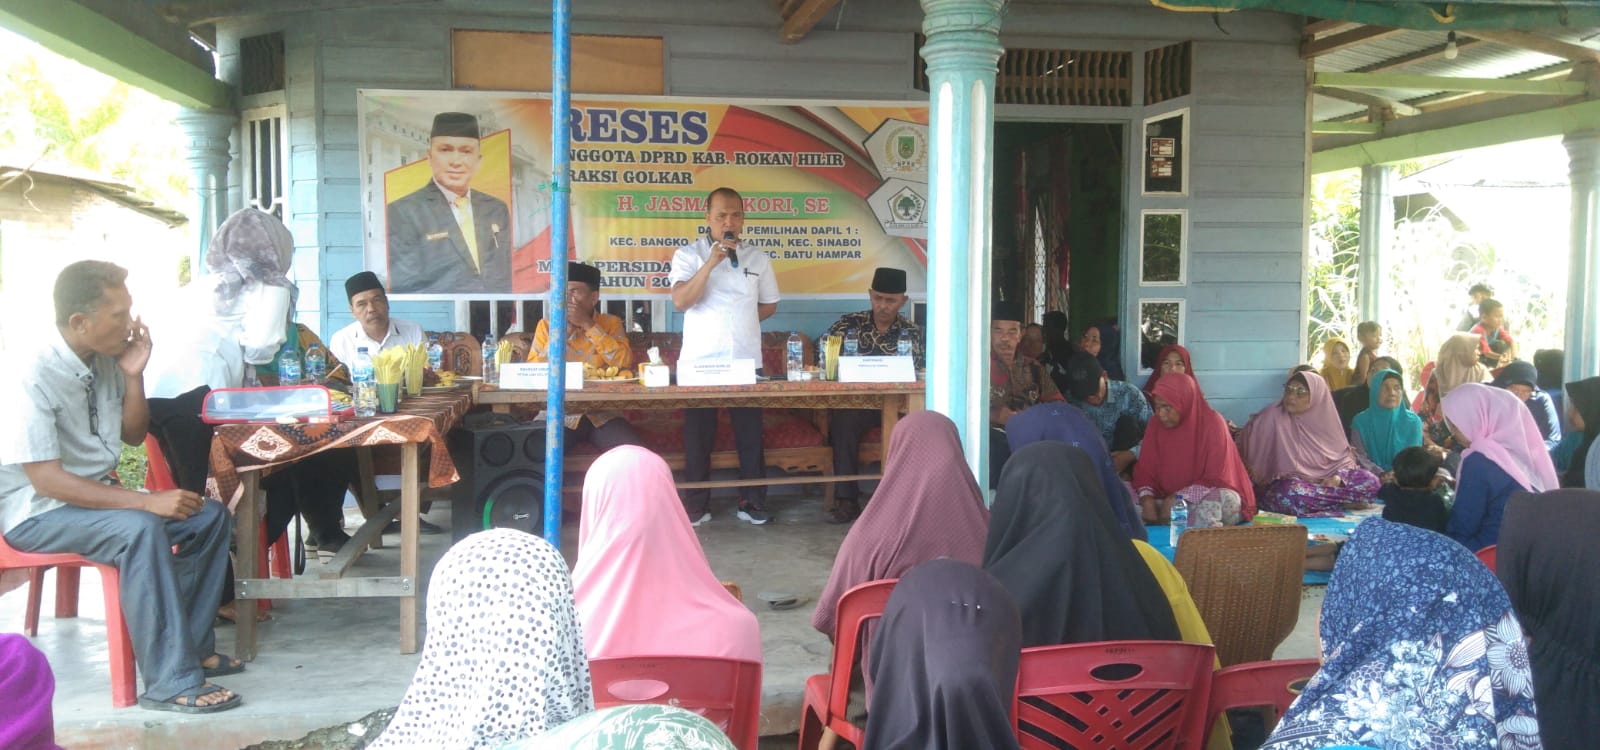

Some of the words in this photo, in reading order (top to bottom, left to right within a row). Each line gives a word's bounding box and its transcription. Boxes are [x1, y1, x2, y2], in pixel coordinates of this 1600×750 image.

[570, 108, 708, 145] RESES
[570, 149, 636, 163] NGGOTA
[640, 151, 687, 164] DPRD
[692, 152, 730, 165] KAB.
[735, 152, 793, 165] ROKAN
[798, 153, 844, 166] HILIR
[570, 169, 618, 183] RAKSI
[623, 171, 693, 184] GOLKAR
[618, 196, 639, 211] H.
[646, 196, 707, 212] JASM
[743, 197, 798, 214] KORI,
[805, 198, 830, 213] SE
[747, 226, 808, 235] PEMILIHAN
[811, 226, 842, 235] DAPIL
[845, 227, 851, 235] 1
[610, 237, 637, 246] KEC.
[640, 237, 689, 247] BANGKO
[788, 238, 813, 247] KEC.
[816, 238, 862, 247] SINABOI
[784, 250, 813, 259] BATU
[816, 250, 862, 259] HAMPAR
[595, 261, 672, 273] PERSIDA
[600, 276, 646, 288] AHUN
[652, 276, 671, 288] 20
